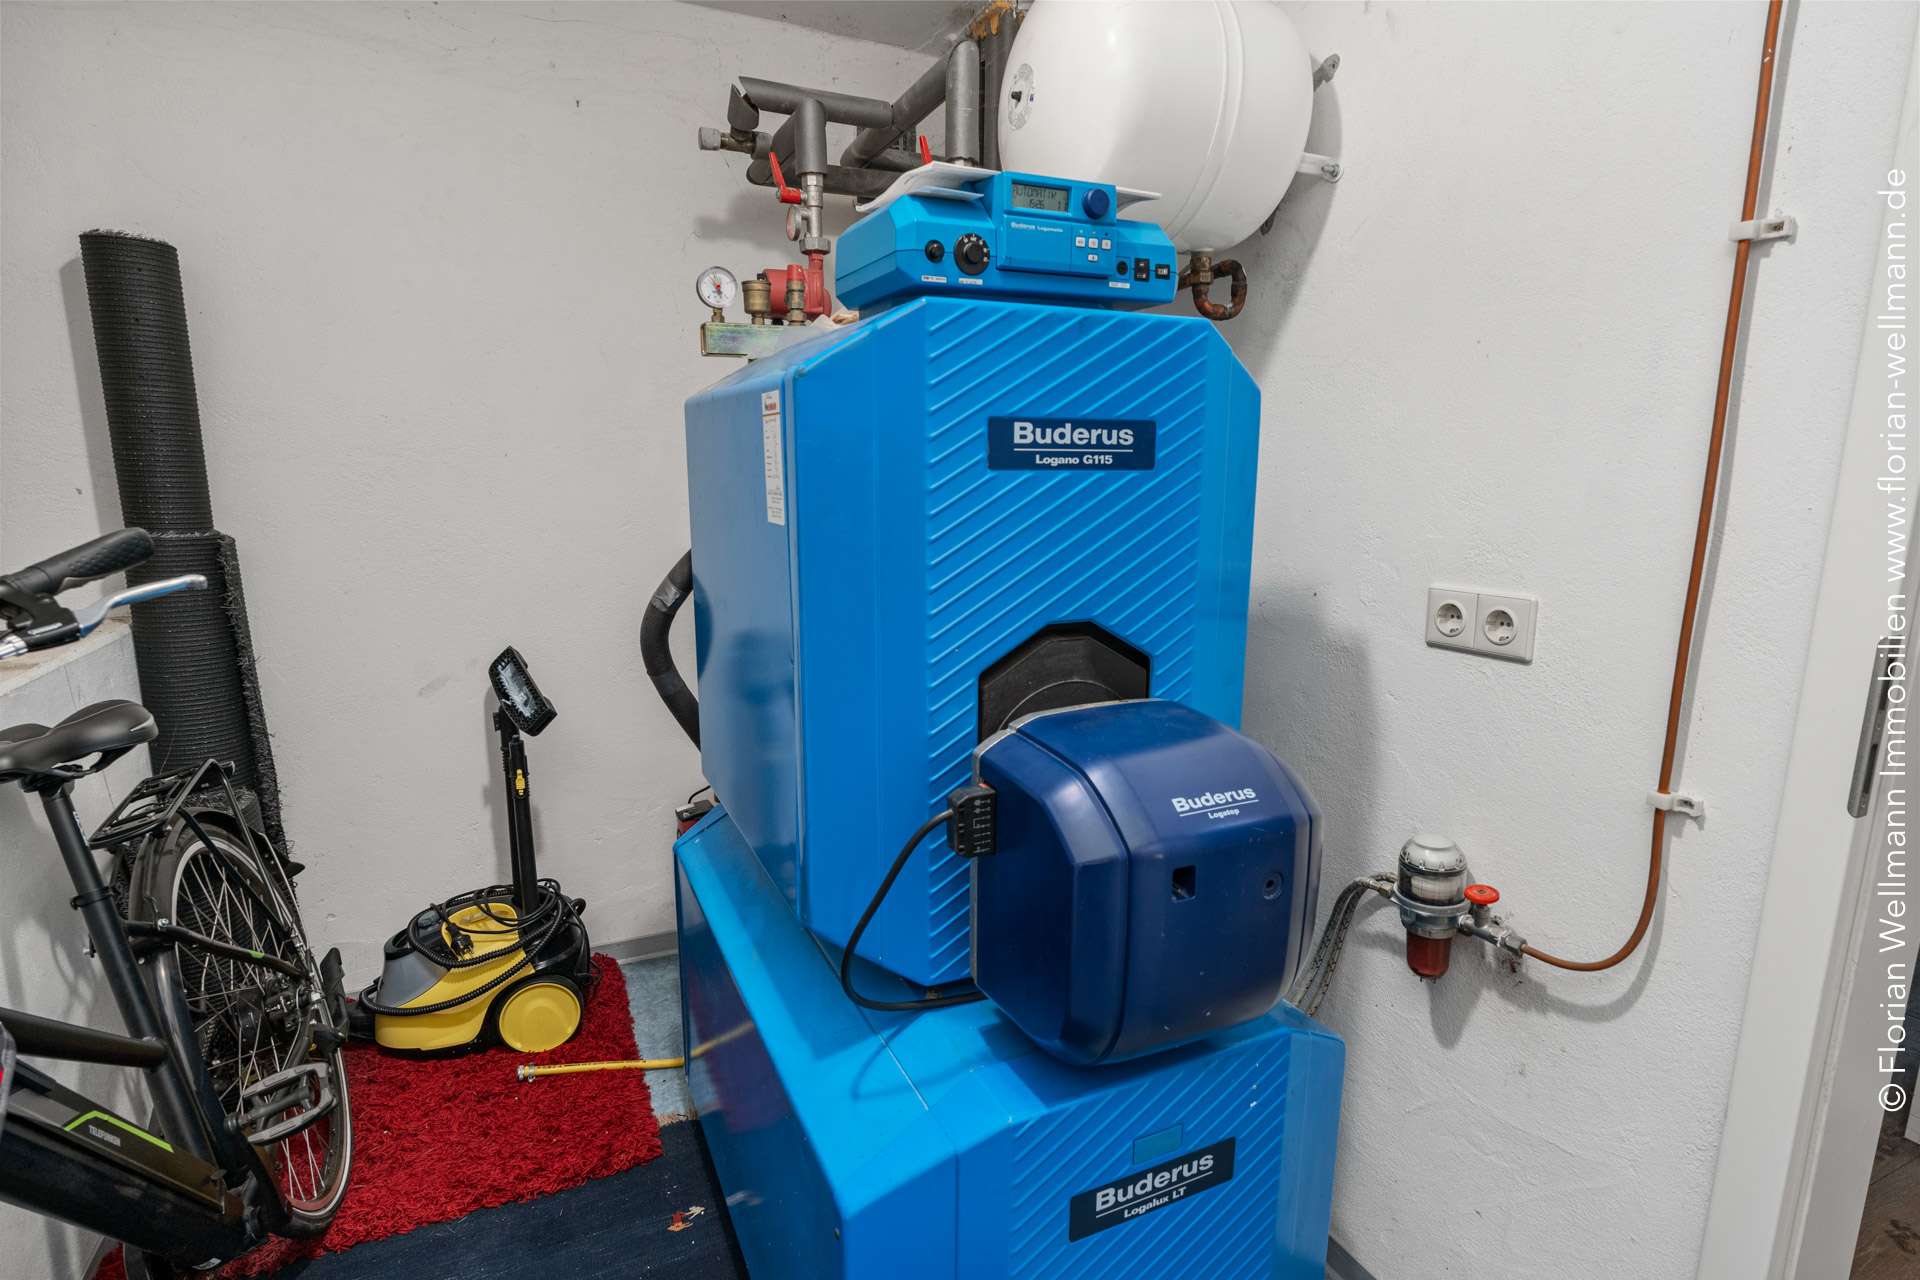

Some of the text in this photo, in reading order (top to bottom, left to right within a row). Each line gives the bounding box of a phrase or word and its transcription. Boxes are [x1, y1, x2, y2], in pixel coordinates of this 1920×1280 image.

[1011, 222, 1036, 230] Buderus
[1013, 421, 1134, 446] Buderus
[1035, 454, 1113, 467] Logano G115
[1171, 788, 1257, 813] Buderus
[1207, 808, 1240, 820] Logatop
[1095, 1153, 1214, 1212] Buderus
[1123, 1186, 1187, 1219] Logalux LT
